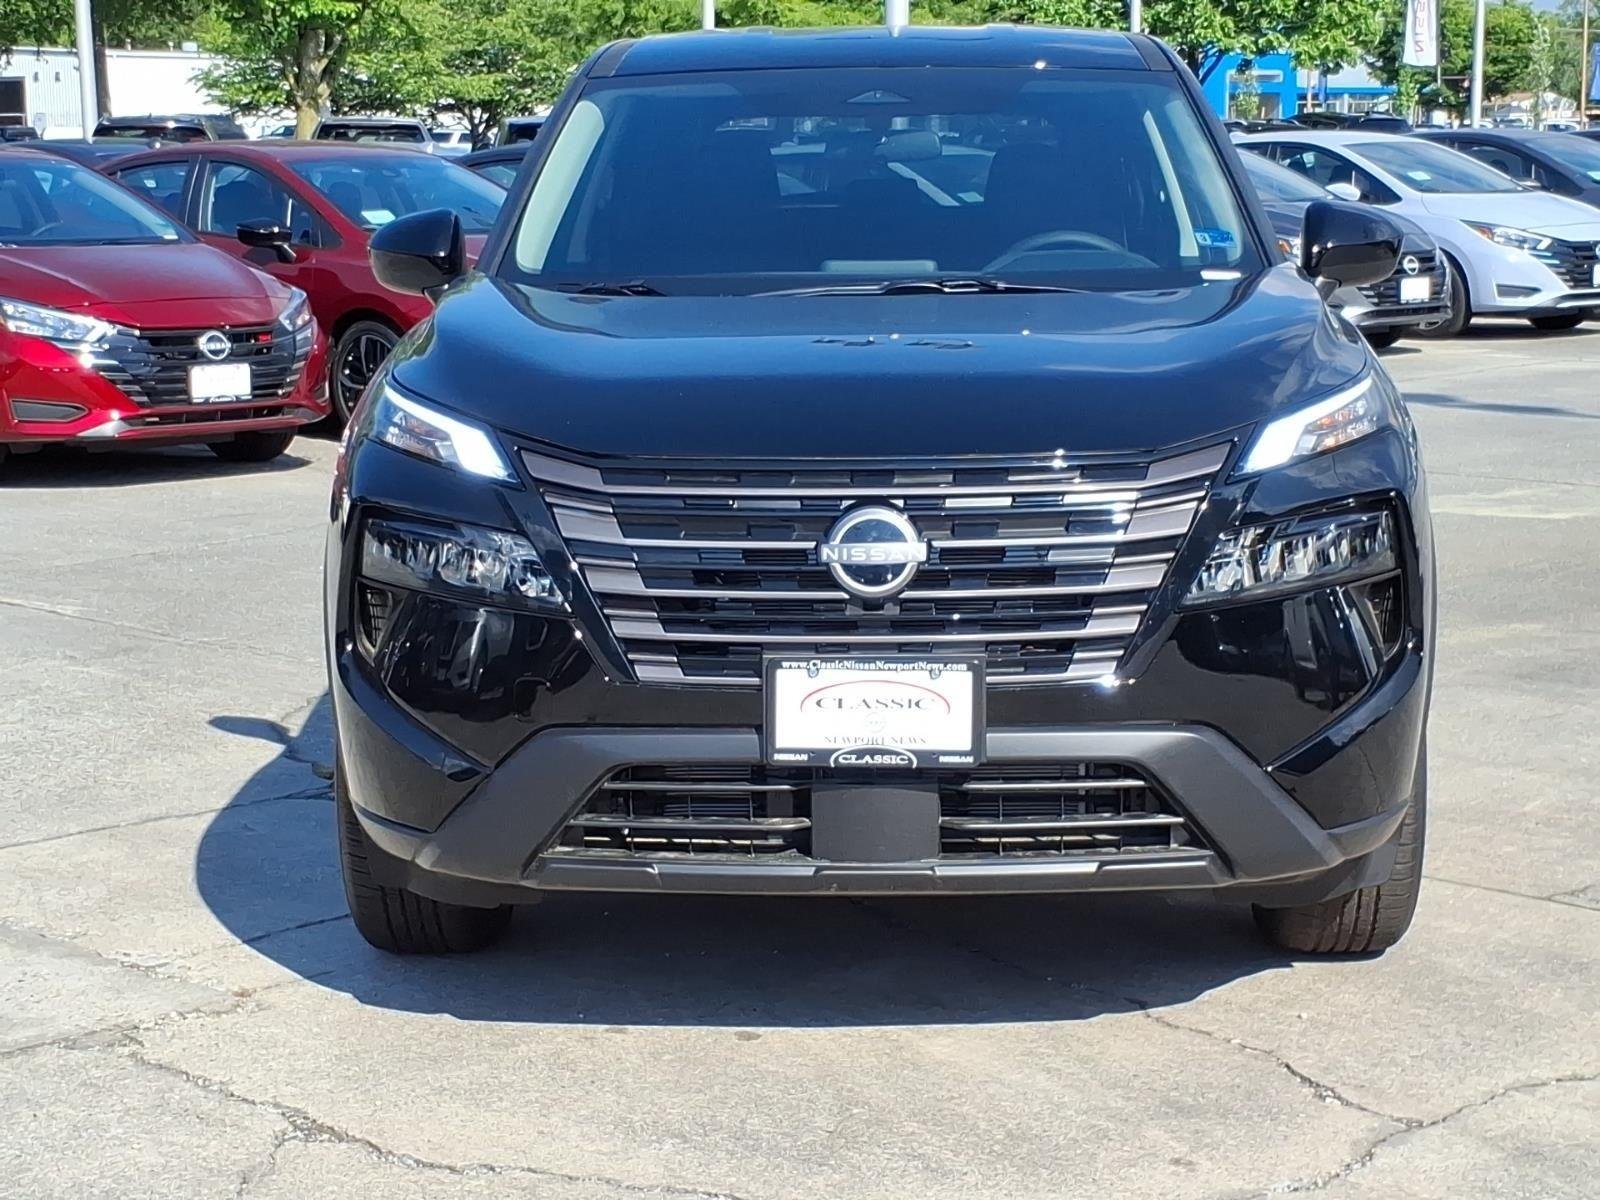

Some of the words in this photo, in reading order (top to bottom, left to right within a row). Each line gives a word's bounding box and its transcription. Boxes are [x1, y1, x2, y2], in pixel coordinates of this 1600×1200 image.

[822, 546, 925, 561] NISSAN
[781, 660, 967, 674] www.ClassicNissanNewportNews.com
[815, 697, 931, 710] CLASSIC
[824, 736, 885, 745] NEWPORT
[891, 736, 928, 745] NEWS
[838, 754, 909, 765] CLASSIC
